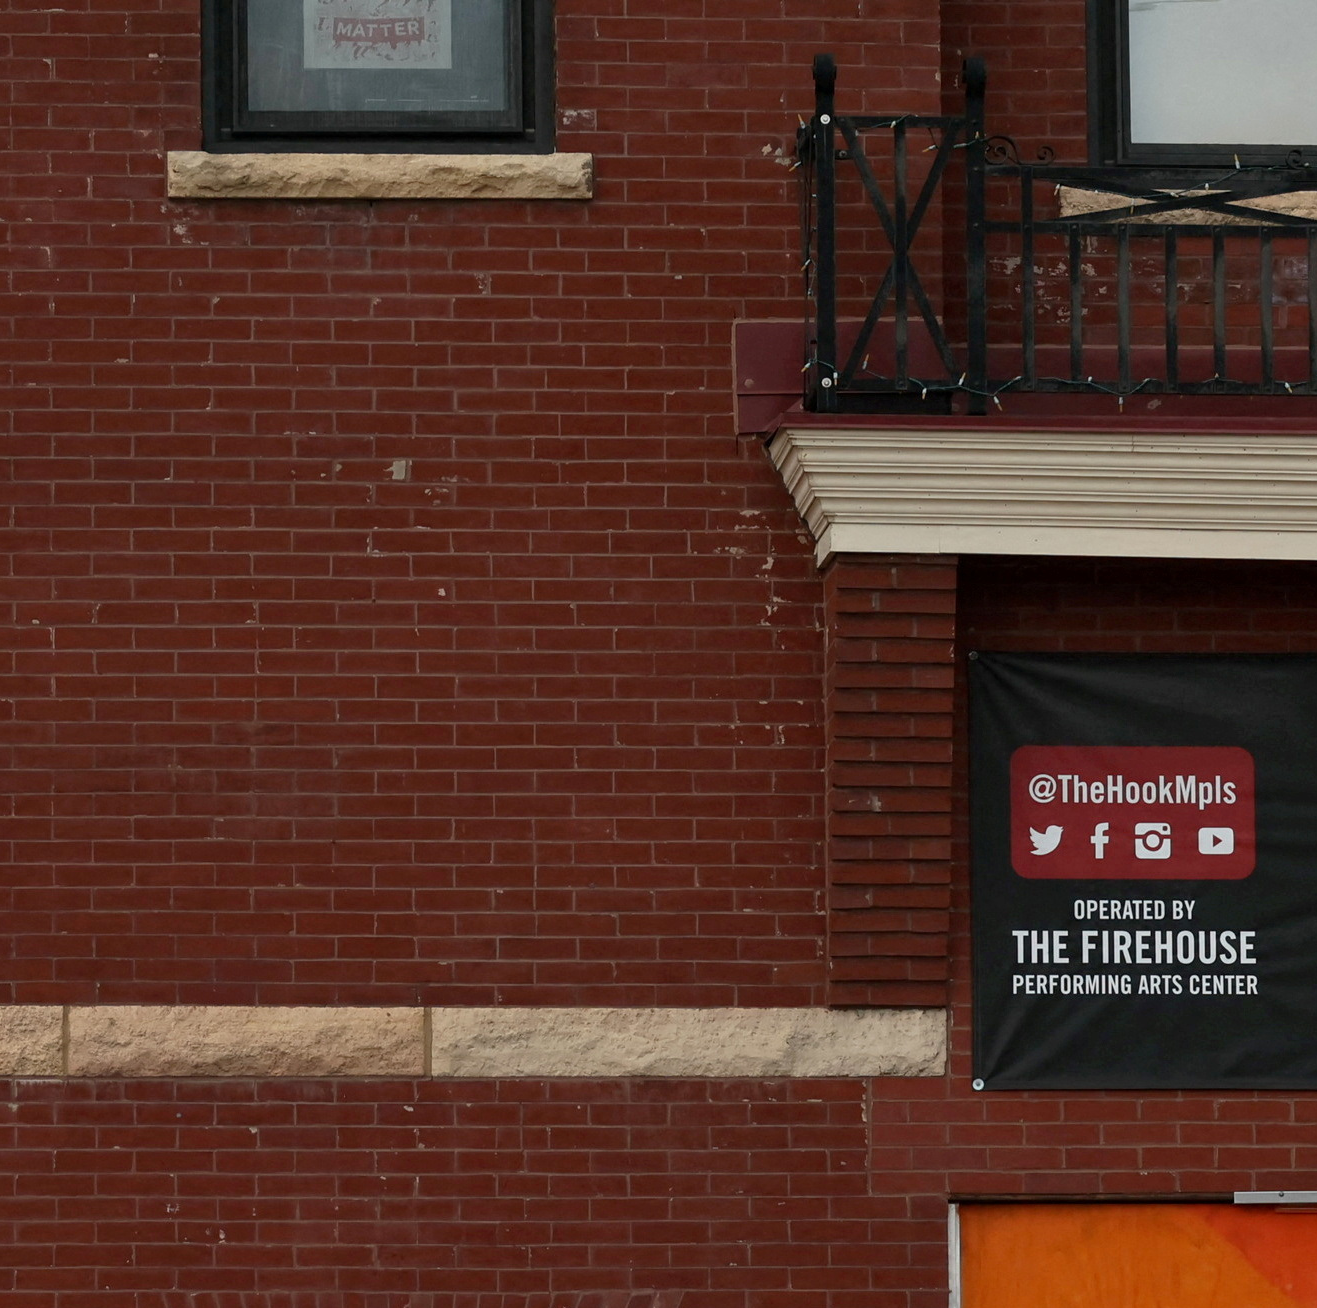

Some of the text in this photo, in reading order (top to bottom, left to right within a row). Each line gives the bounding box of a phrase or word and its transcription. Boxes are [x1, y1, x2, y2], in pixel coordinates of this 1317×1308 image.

[336, 21, 420, 37] MATTER
[1028, 773, 1237, 811] @TheHookMpls
[1074, 899, 1196, 920] OPERATED BY
[1011, 929, 1257, 965] THE FIREHOUSE
[1012, 973, 1259, 995] PERFORMING ARTS CENTER
